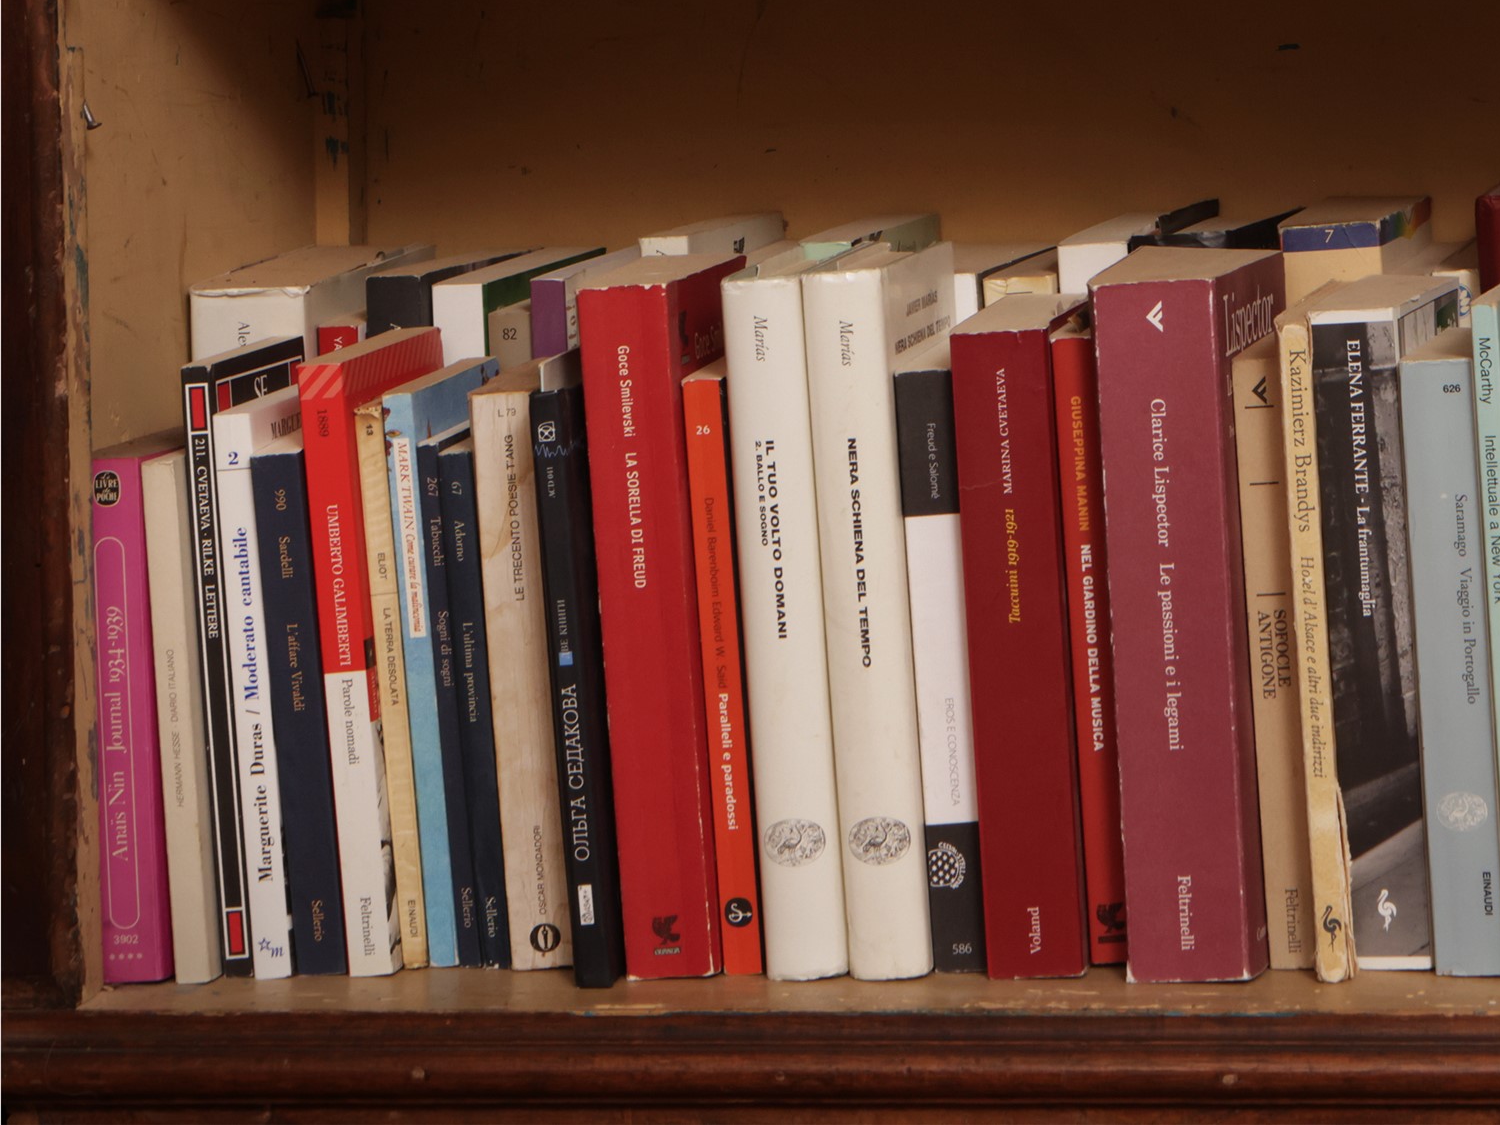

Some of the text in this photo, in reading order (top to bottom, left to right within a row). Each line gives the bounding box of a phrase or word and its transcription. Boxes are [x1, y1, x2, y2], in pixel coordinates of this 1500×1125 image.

[618, 346, 635, 437] Goce Smilevski
[1346, 339, 1369, 494] ELENA FERRANTE
[1478, 338, 1493, 404] McCarthy
[996, 368, 1012, 494] MARINA CVETAEVA
[1150, 399, 1171, 547] Clarice Lispector
[1289, 349, 1315, 532] Kazimierz Brandys
[1485, 435, 1500, 516] Intellettuale
[195, 439, 219, 639] 211. CVETAEVA RILKE LETTERE
[625, 453, 646, 588] LA SORELLA DI FREUD
[765, 440, 787, 639] IL TUO VOLTO DOMANI
[1454, 494, 1468, 557] Saramago
[1490, 522, 1499, 530] a
[326, 504, 351, 665] UMBERTO GALIMBERTI
[232, 528, 274, 882] Marguerite Duras Moderato cantabile
[1258, 611, 1276, 698] ANTIGONE
[1274, 609, 1291, 687] SOFOCLE
[561, 684, 584, 789] СЕДАКОВА
[571, 796, 589, 861] ОЛЬГА
